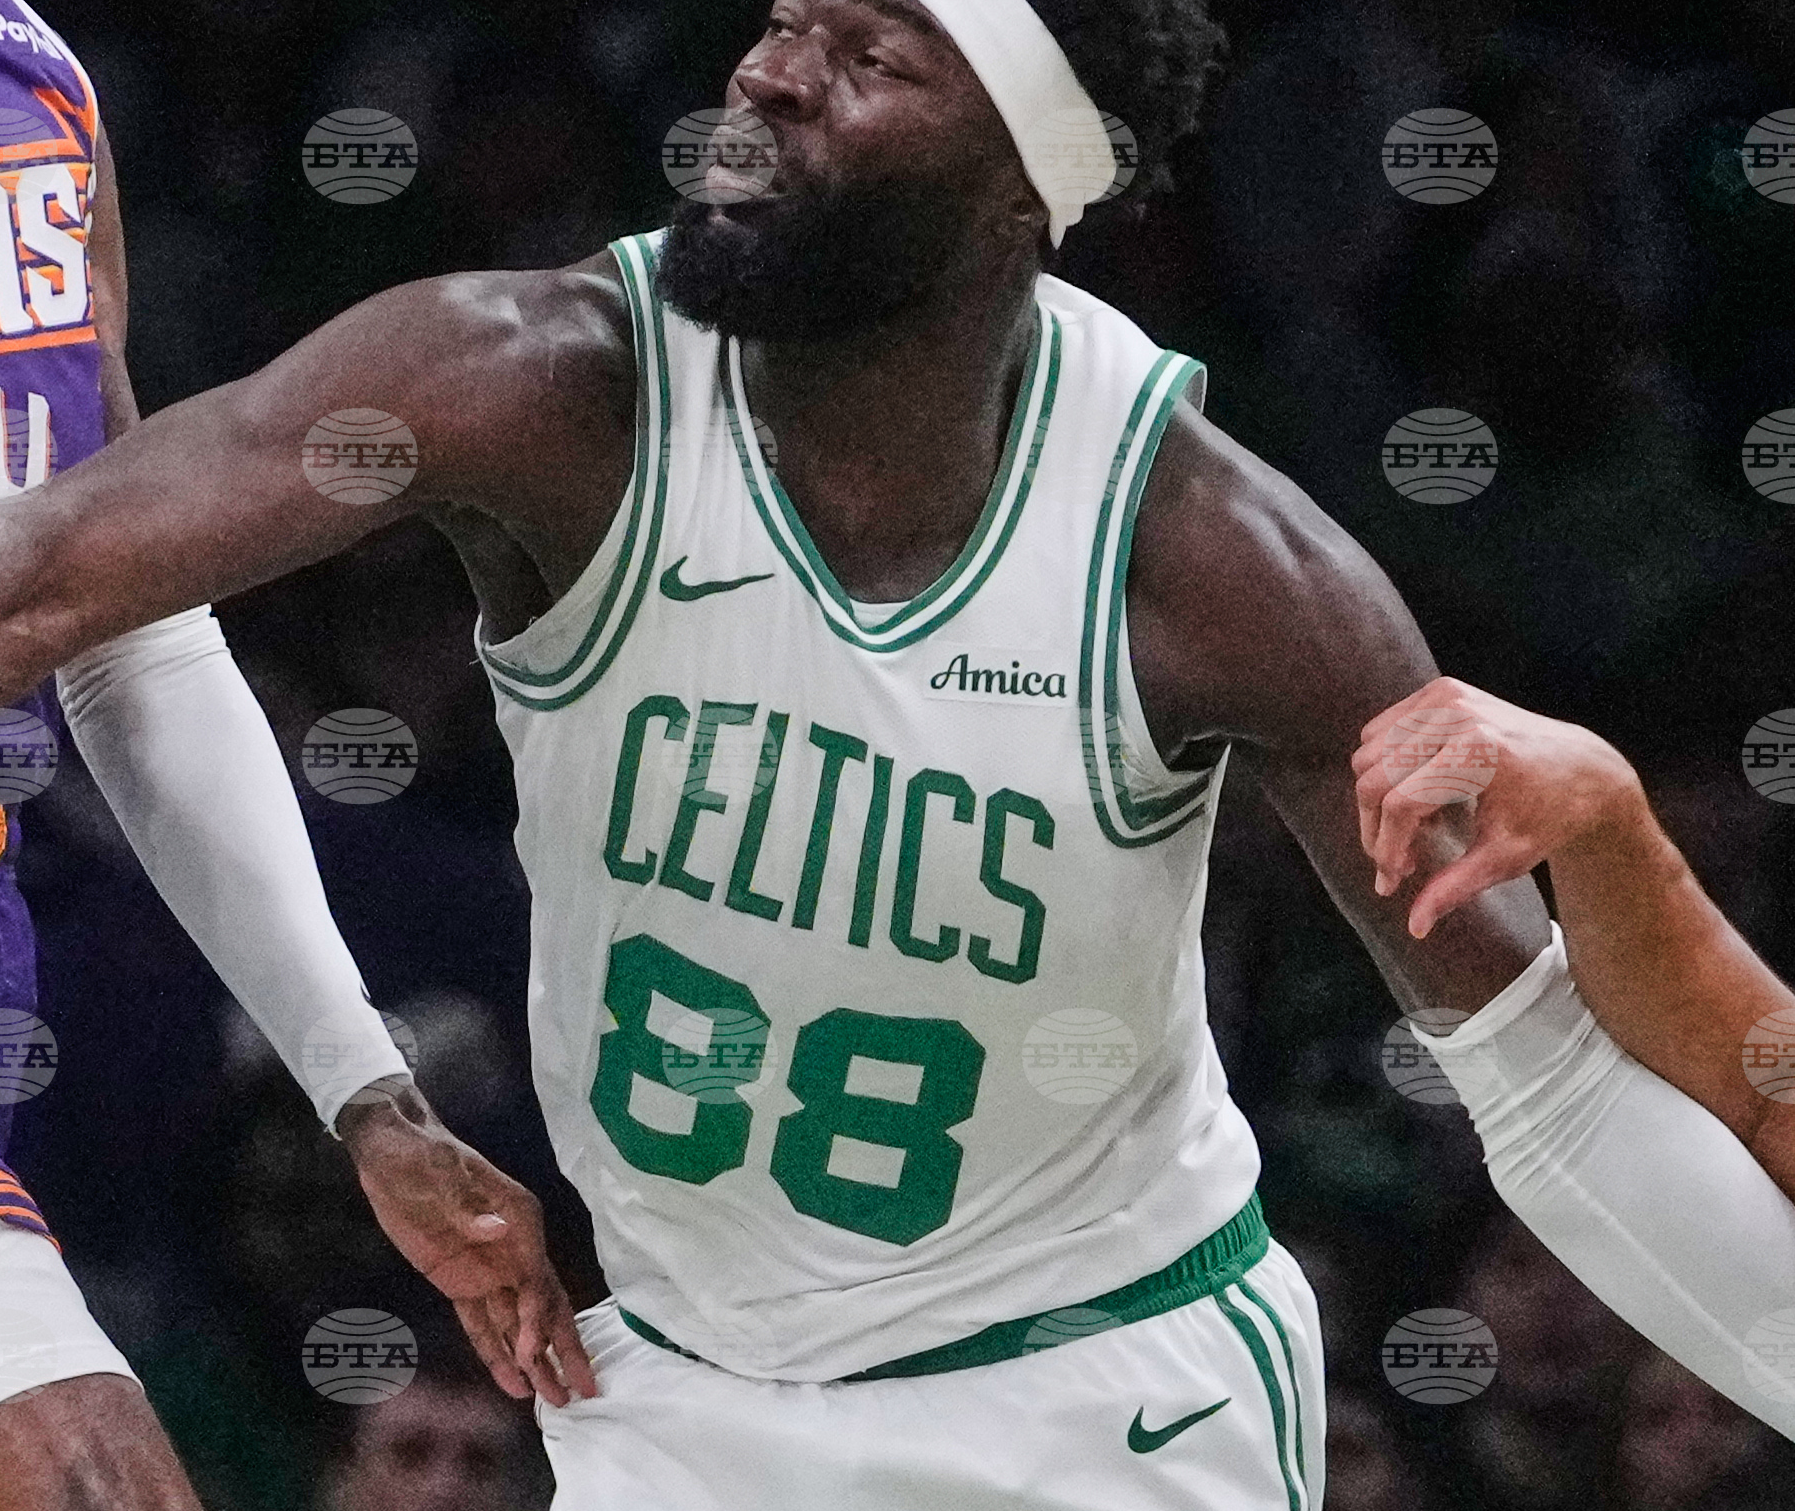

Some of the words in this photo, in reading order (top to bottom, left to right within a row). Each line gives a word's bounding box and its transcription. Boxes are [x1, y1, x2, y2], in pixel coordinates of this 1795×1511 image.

[930, 653, 1067, 698] Amica
[604, 695, 1056, 985] CELTICS
[590, 933, 987, 1248] 88
